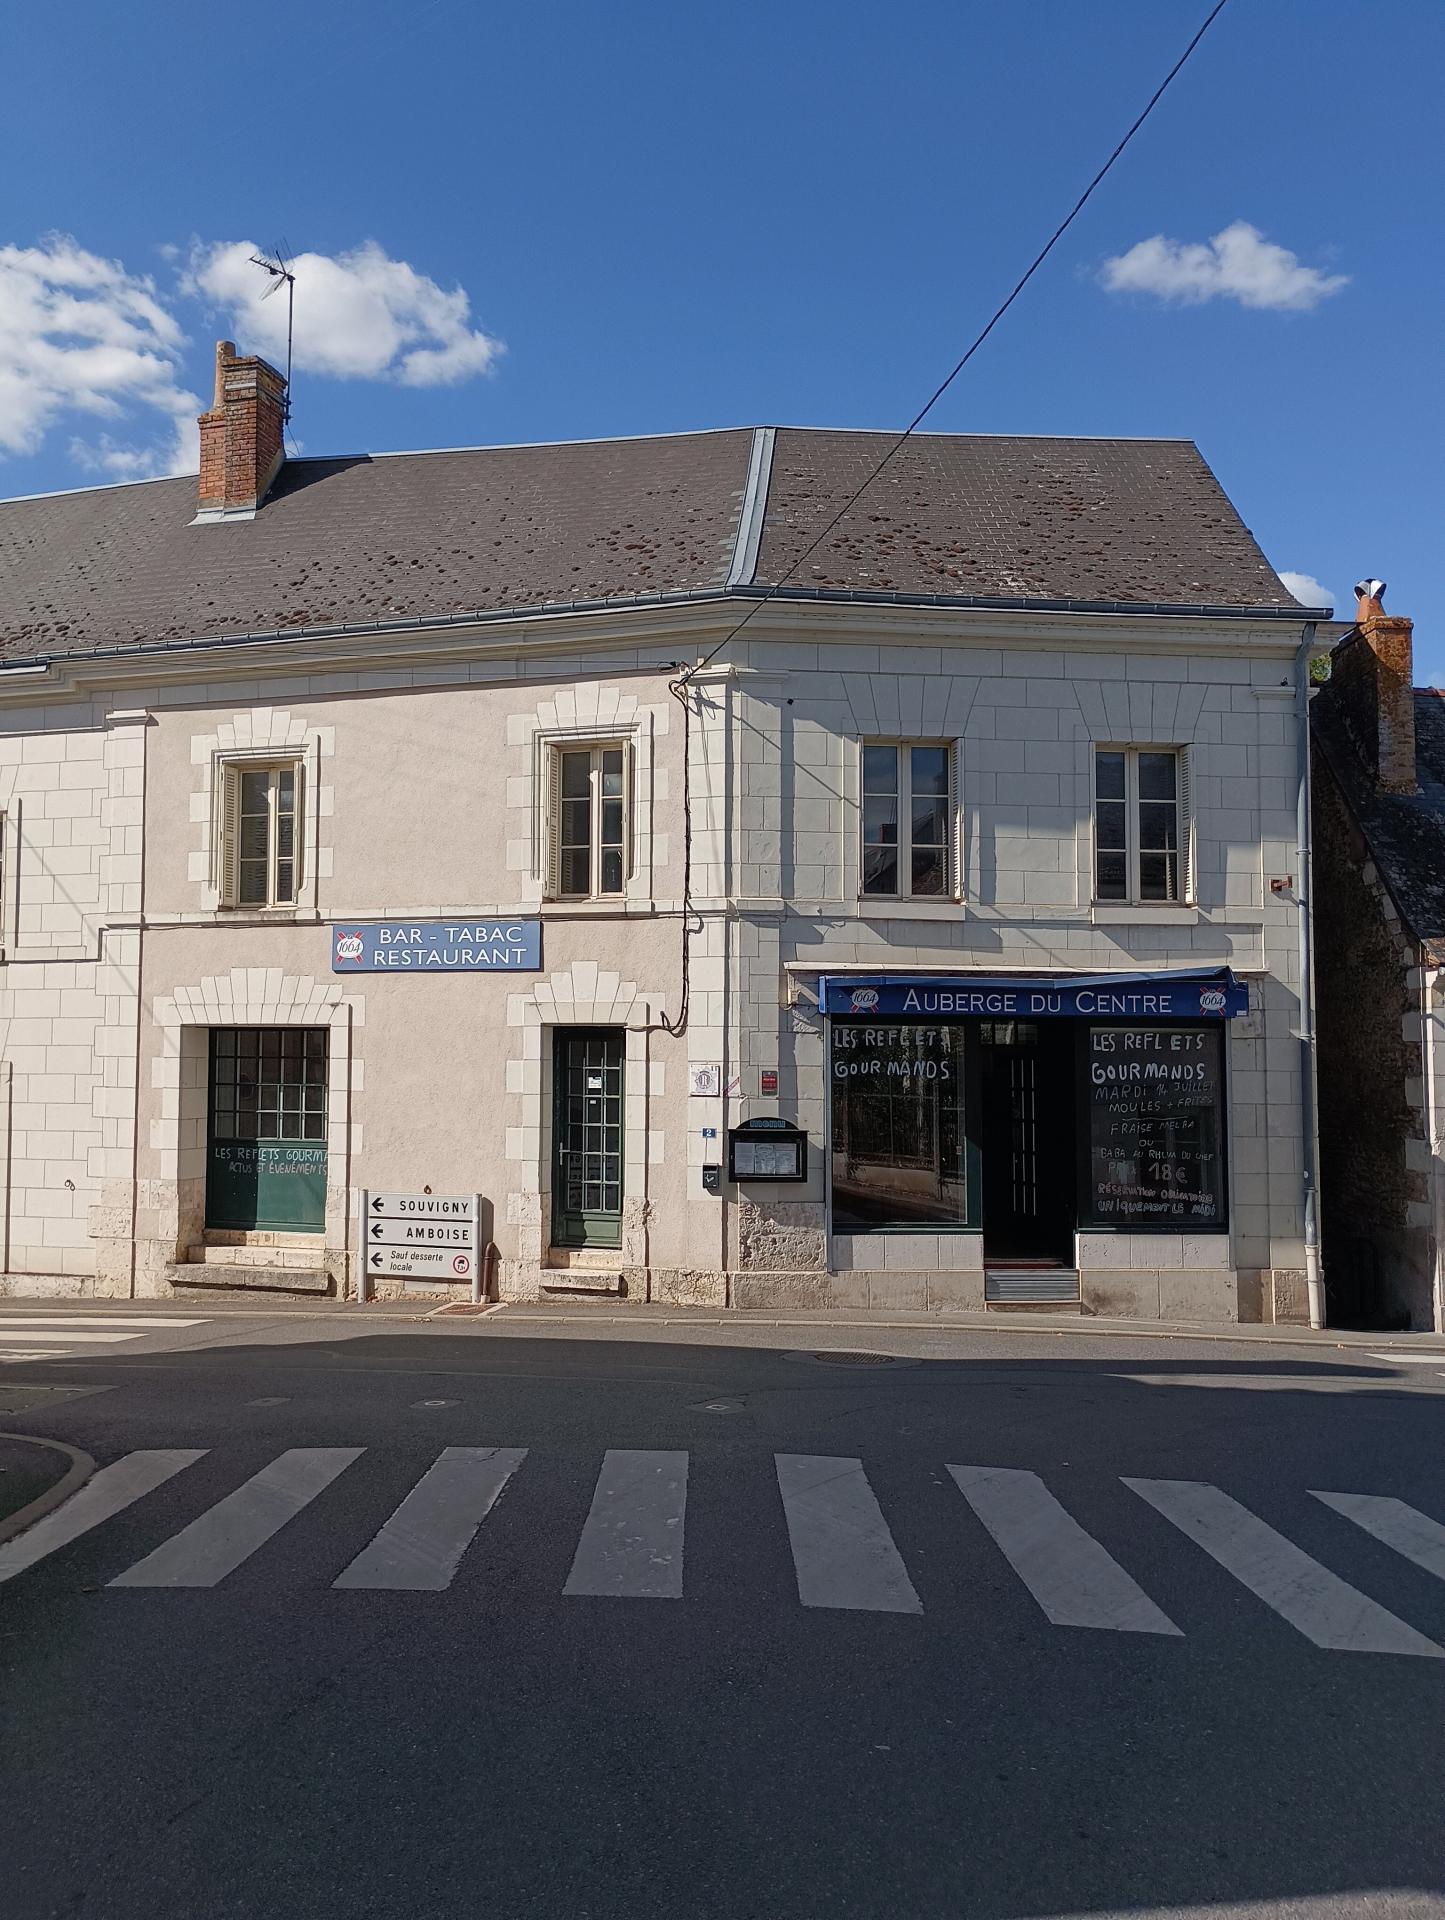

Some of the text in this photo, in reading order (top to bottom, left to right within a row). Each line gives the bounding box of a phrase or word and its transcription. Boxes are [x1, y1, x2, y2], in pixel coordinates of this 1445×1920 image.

[380, 929, 424, 944] BAR
[444, 927, 523, 943] TABAC
[339, 940, 361, 953] 1664
[373, 948, 528, 966] RESTAURANT
[854, 990, 877, 1004] 1664
[1202, 994, 1225, 1006] 1664
[1031, 995, 1061, 1013] DU
[833, 1028, 857, 1048] LES
[1093, 1033, 1205, 1052] LES REFLETS
[1092, 1062, 1205, 1084] GOURMANDS
[1156, 1084, 1168, 1096] 14
[1109, 1101, 1160, 1113] MOULES
[1139, 1139, 1154, 1147] OU
[215, 1147, 231, 1159] LES
[237, 1147, 280, 1160] REFLETS
[228, 1161, 252, 1173] ACTUS
[256, 1162, 266, 1173] ET
[399, 1200, 469, 1213] SOUVIGNY
[406, 1227, 469, 1240] AMBOISE
[390, 1250, 444, 1262] Sauf desserte
[390, 1262, 413, 1271] locale
